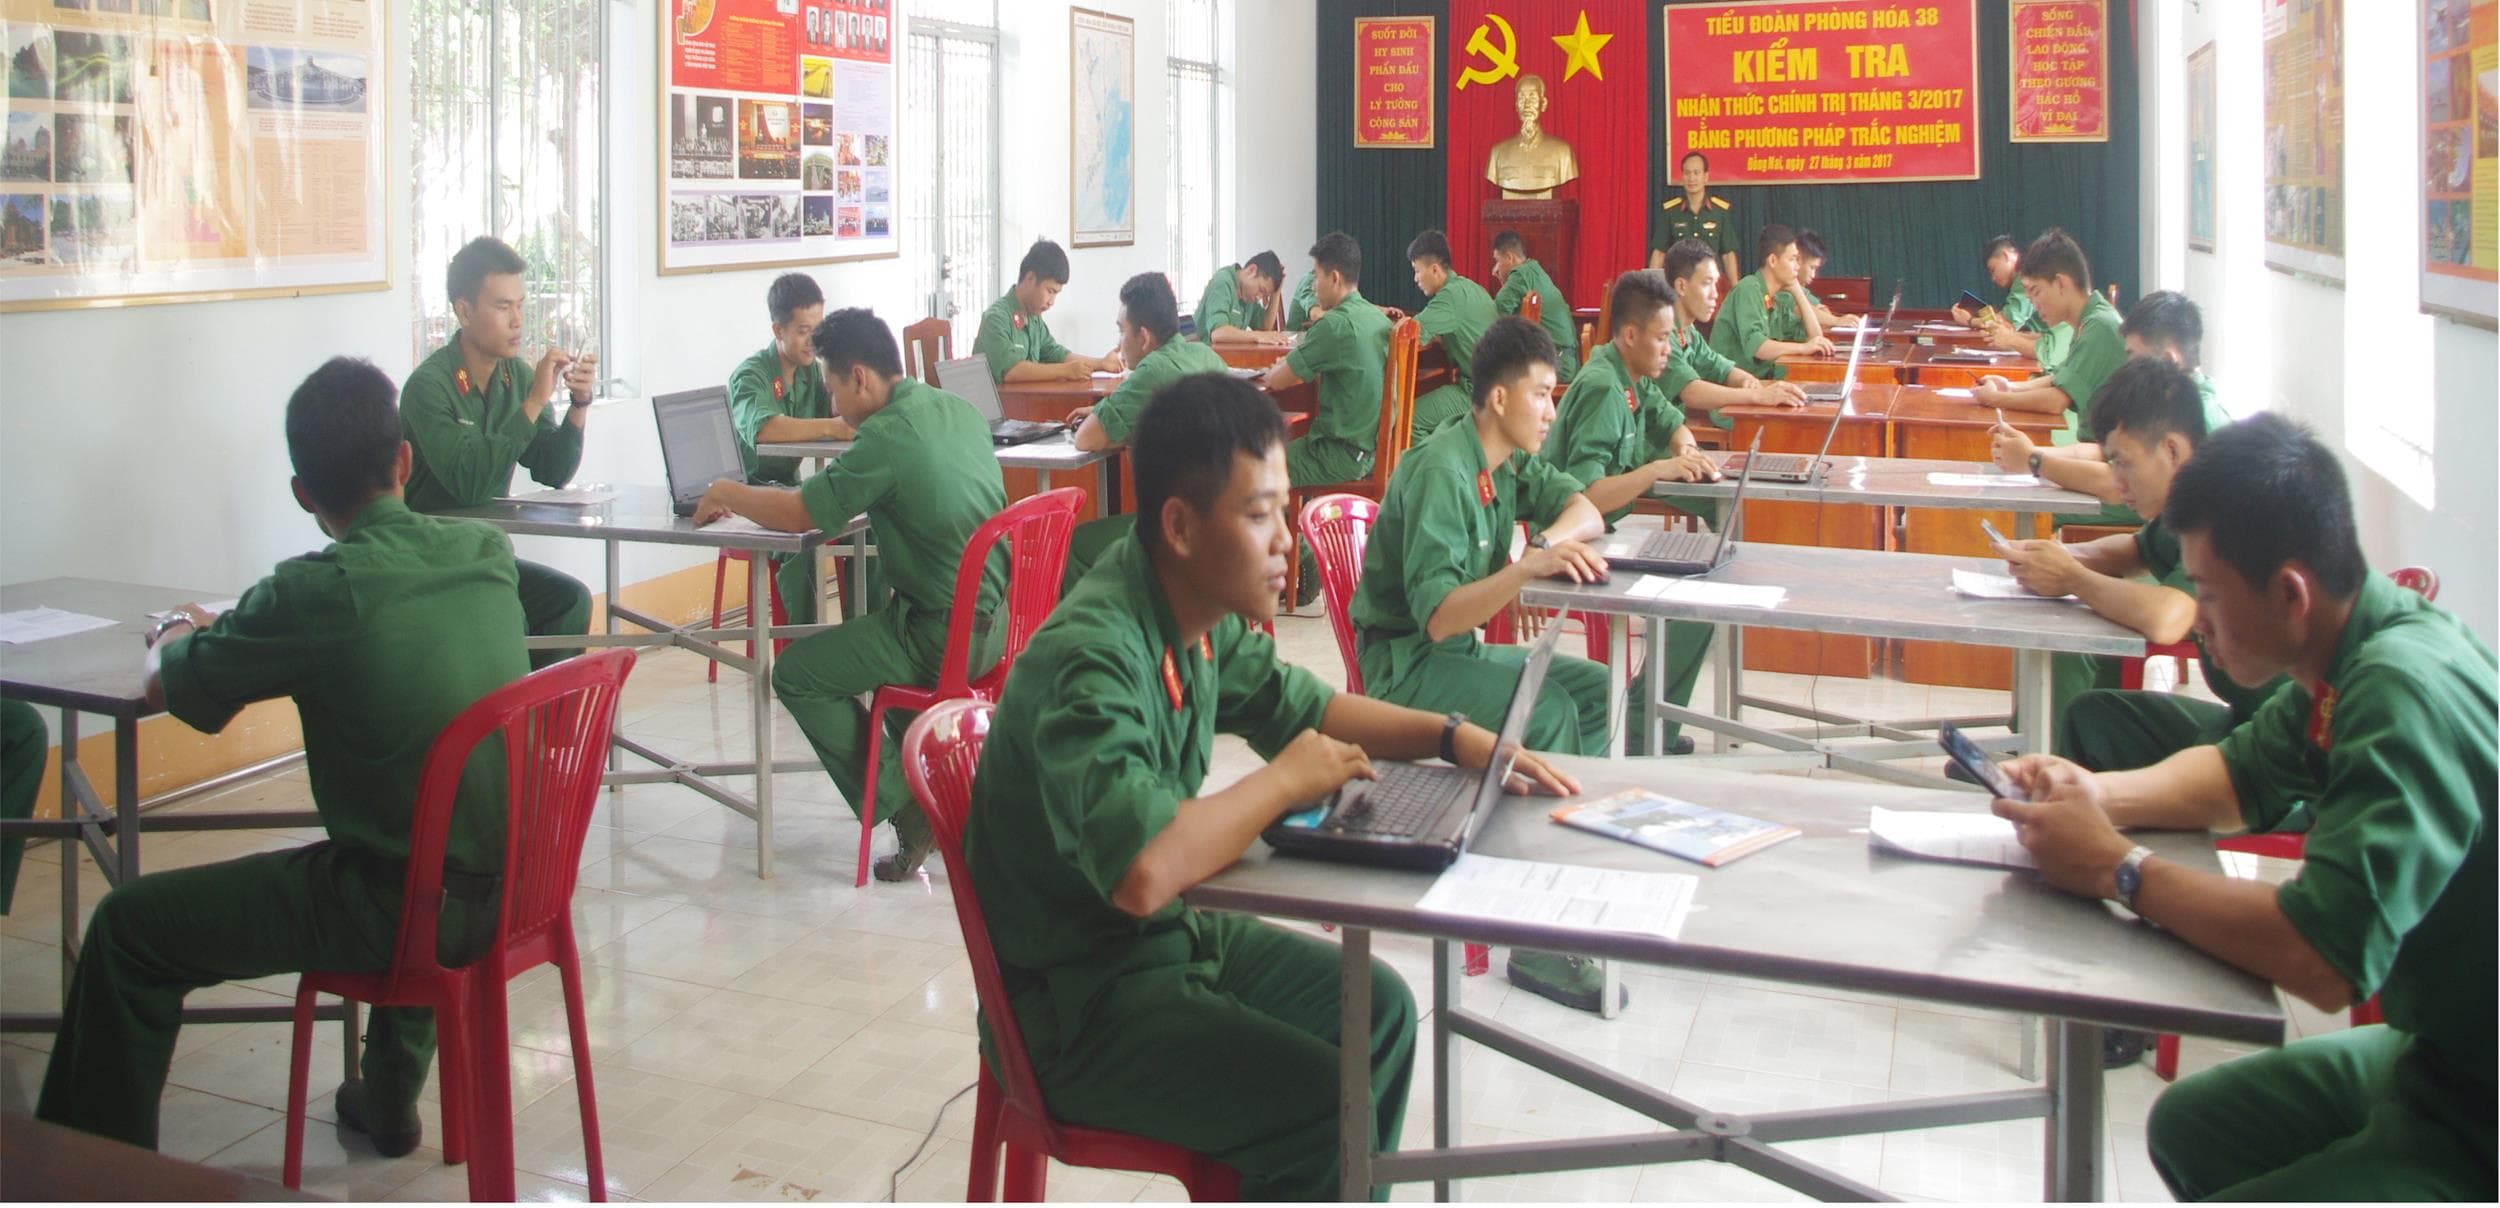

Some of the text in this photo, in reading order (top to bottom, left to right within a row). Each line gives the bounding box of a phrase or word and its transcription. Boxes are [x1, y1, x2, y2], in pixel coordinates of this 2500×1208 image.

[1705, 4, 1938, 34] TIỂU ĐOÀN PHÒNG HÓA 38
[2042, 6, 2074, 20] SỐNG
[1371, 26, 1397, 40] SUỐT
[2026, 22, 2062, 38] CHIẾN
[1374, 47, 1414, 56] HY SINH
[2027, 44, 2048, 54] LAO
[1733, 36, 1910, 83] KIỂM TRA
[1370, 60, 1396, 75] PHẤN
[1384, 82, 1404, 92] CHO
[2020, 78, 2052, 88] THEO
[1676, 88, 1964, 120] NHẬN THỨC CHÍNH TRỊ THÁNG 3/2017
[1687, 118, 1960, 150] BẰNG PHƯƠNG PHÁP TRẮC NGHIỆM
[1747, 154, 1767, 172] Đồng
[1785, 154, 1806, 172] ngày
[1809, 156, 1820, 170] 27
[1821, 154, 1844, 171] tháng
[1846, 155, 1852, 170] 3
[1854, 154, 1871, 168] năm
[1872, 154, 1893, 168] 2017
